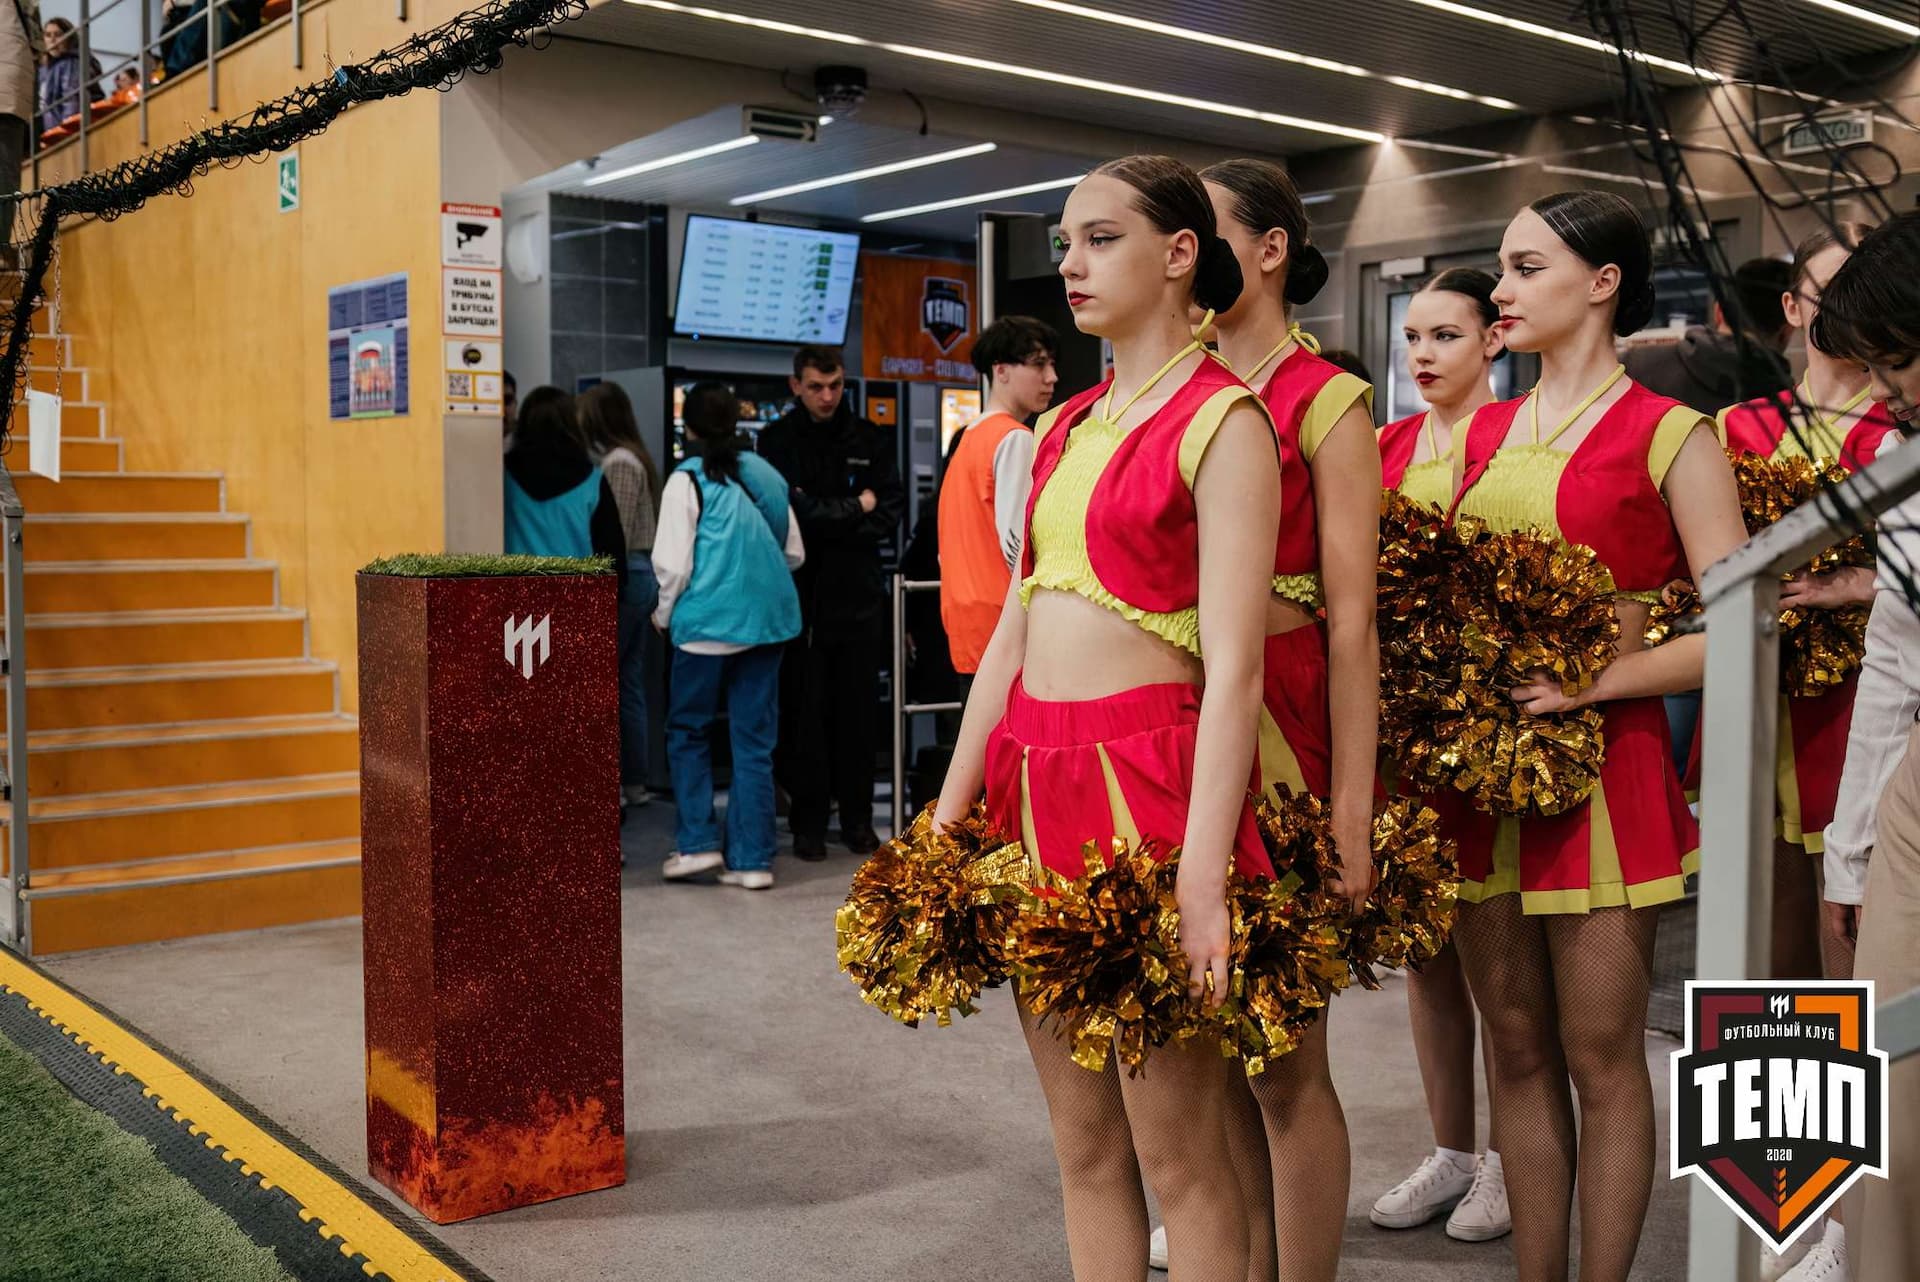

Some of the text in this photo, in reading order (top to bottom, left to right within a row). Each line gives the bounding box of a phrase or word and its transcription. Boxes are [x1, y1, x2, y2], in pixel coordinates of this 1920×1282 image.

[453, 277, 491, 288] ВХОД НА
[451, 290, 494, 301] ТРИБУНЫ
[451, 303, 494, 313] В БУТСАХ
